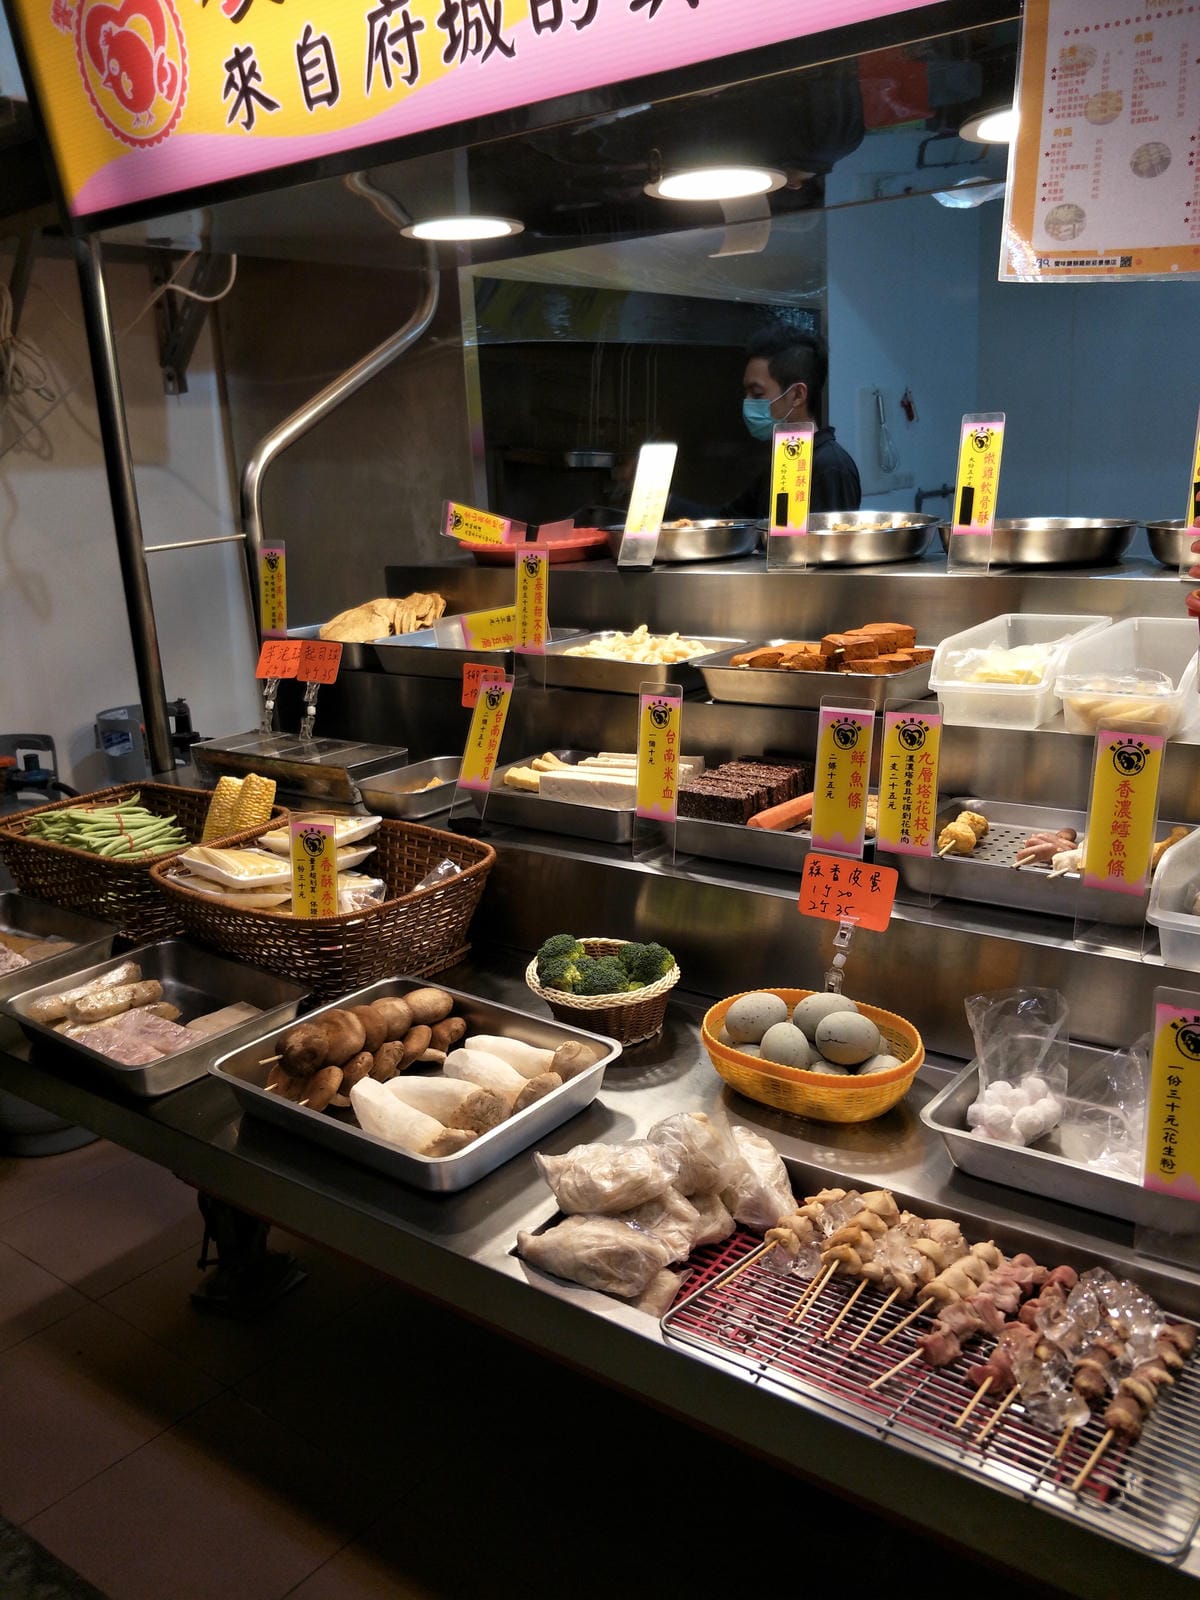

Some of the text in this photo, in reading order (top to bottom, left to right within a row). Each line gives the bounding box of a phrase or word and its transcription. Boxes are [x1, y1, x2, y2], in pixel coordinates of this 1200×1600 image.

[221, 0, 703, 130] 來自府城的
[648, 733, 657, 765] 一個十元
[661, 728, 676, 800] 台南米血
[825, 753, 838, 800] 二條十五元
[847, 750, 867, 810] 鮮魚條
[913, 751, 935, 848] 九層塔花枝丸
[1107, 779, 1136, 879] 香濃鱈魚條
[297, 858, 306, 899] 一份三十元
[807, 860, 882, 894] 蒜香皮蛋
